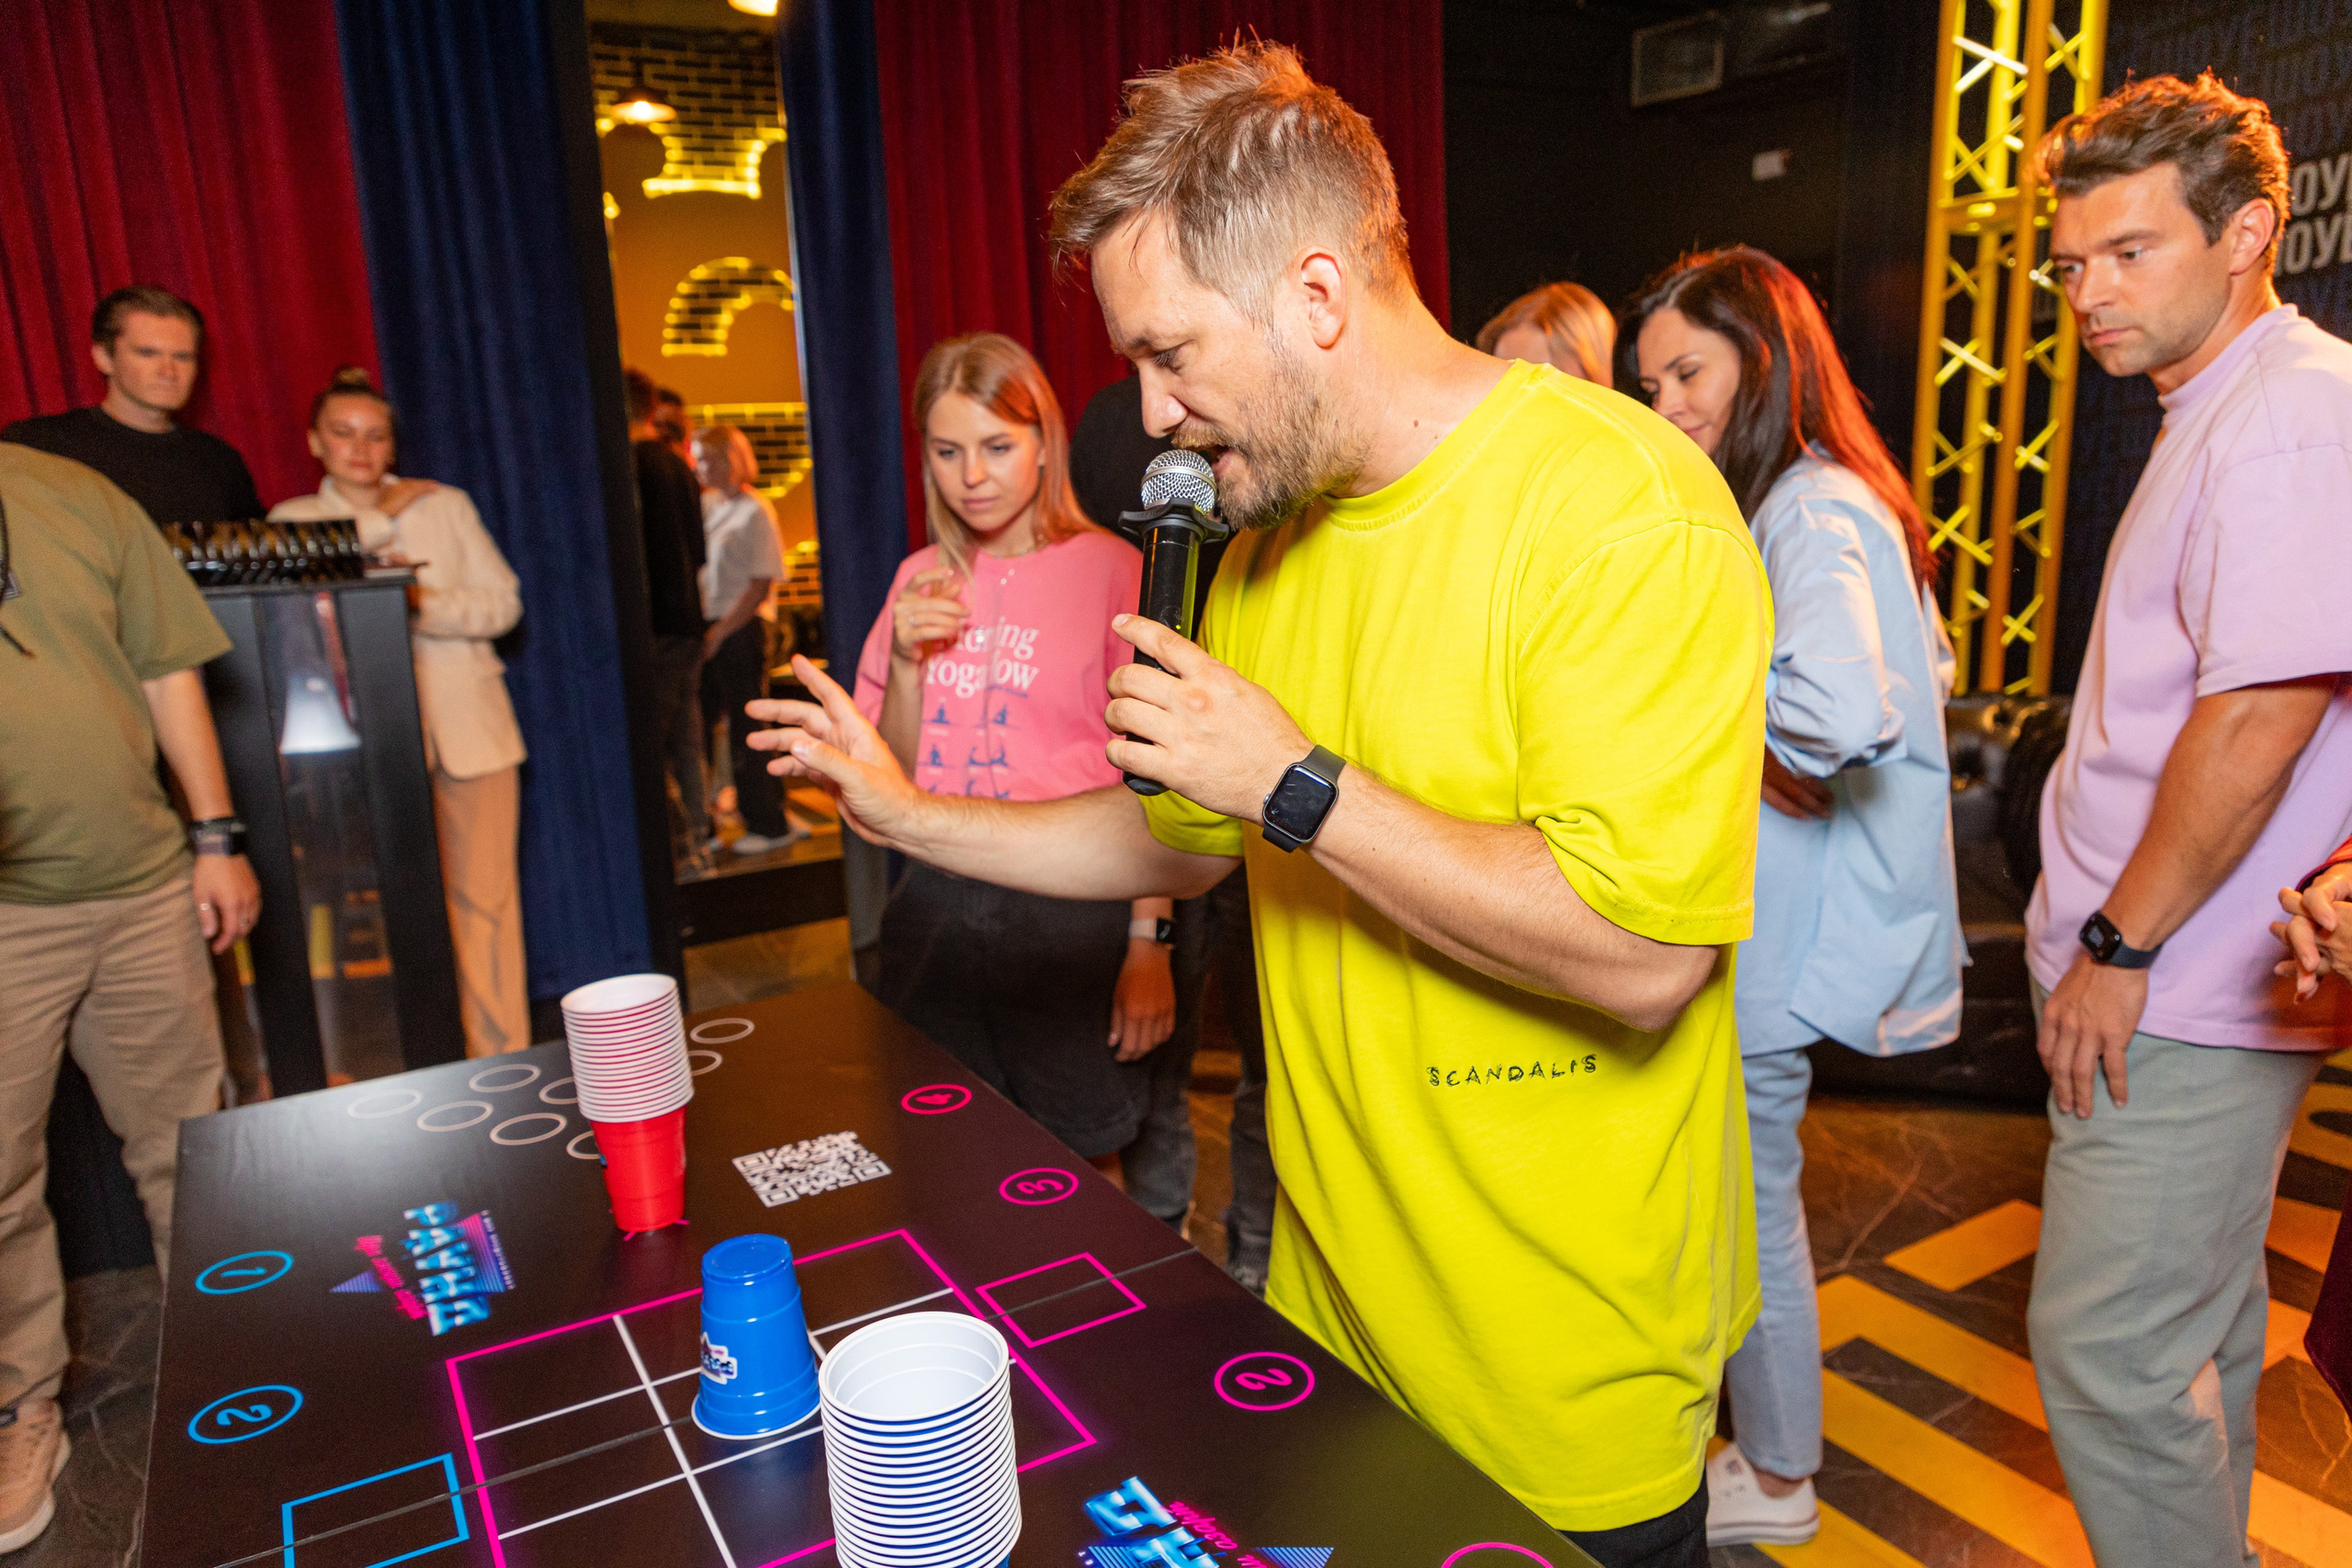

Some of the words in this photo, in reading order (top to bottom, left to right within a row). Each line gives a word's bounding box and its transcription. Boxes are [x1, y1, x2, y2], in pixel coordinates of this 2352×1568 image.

[1016, 1179, 1064, 1194] 3
[220, 1267, 266, 1278] 1
[1235, 1368, 1293, 1391] 2
[216, 1404, 273, 1427] 2
